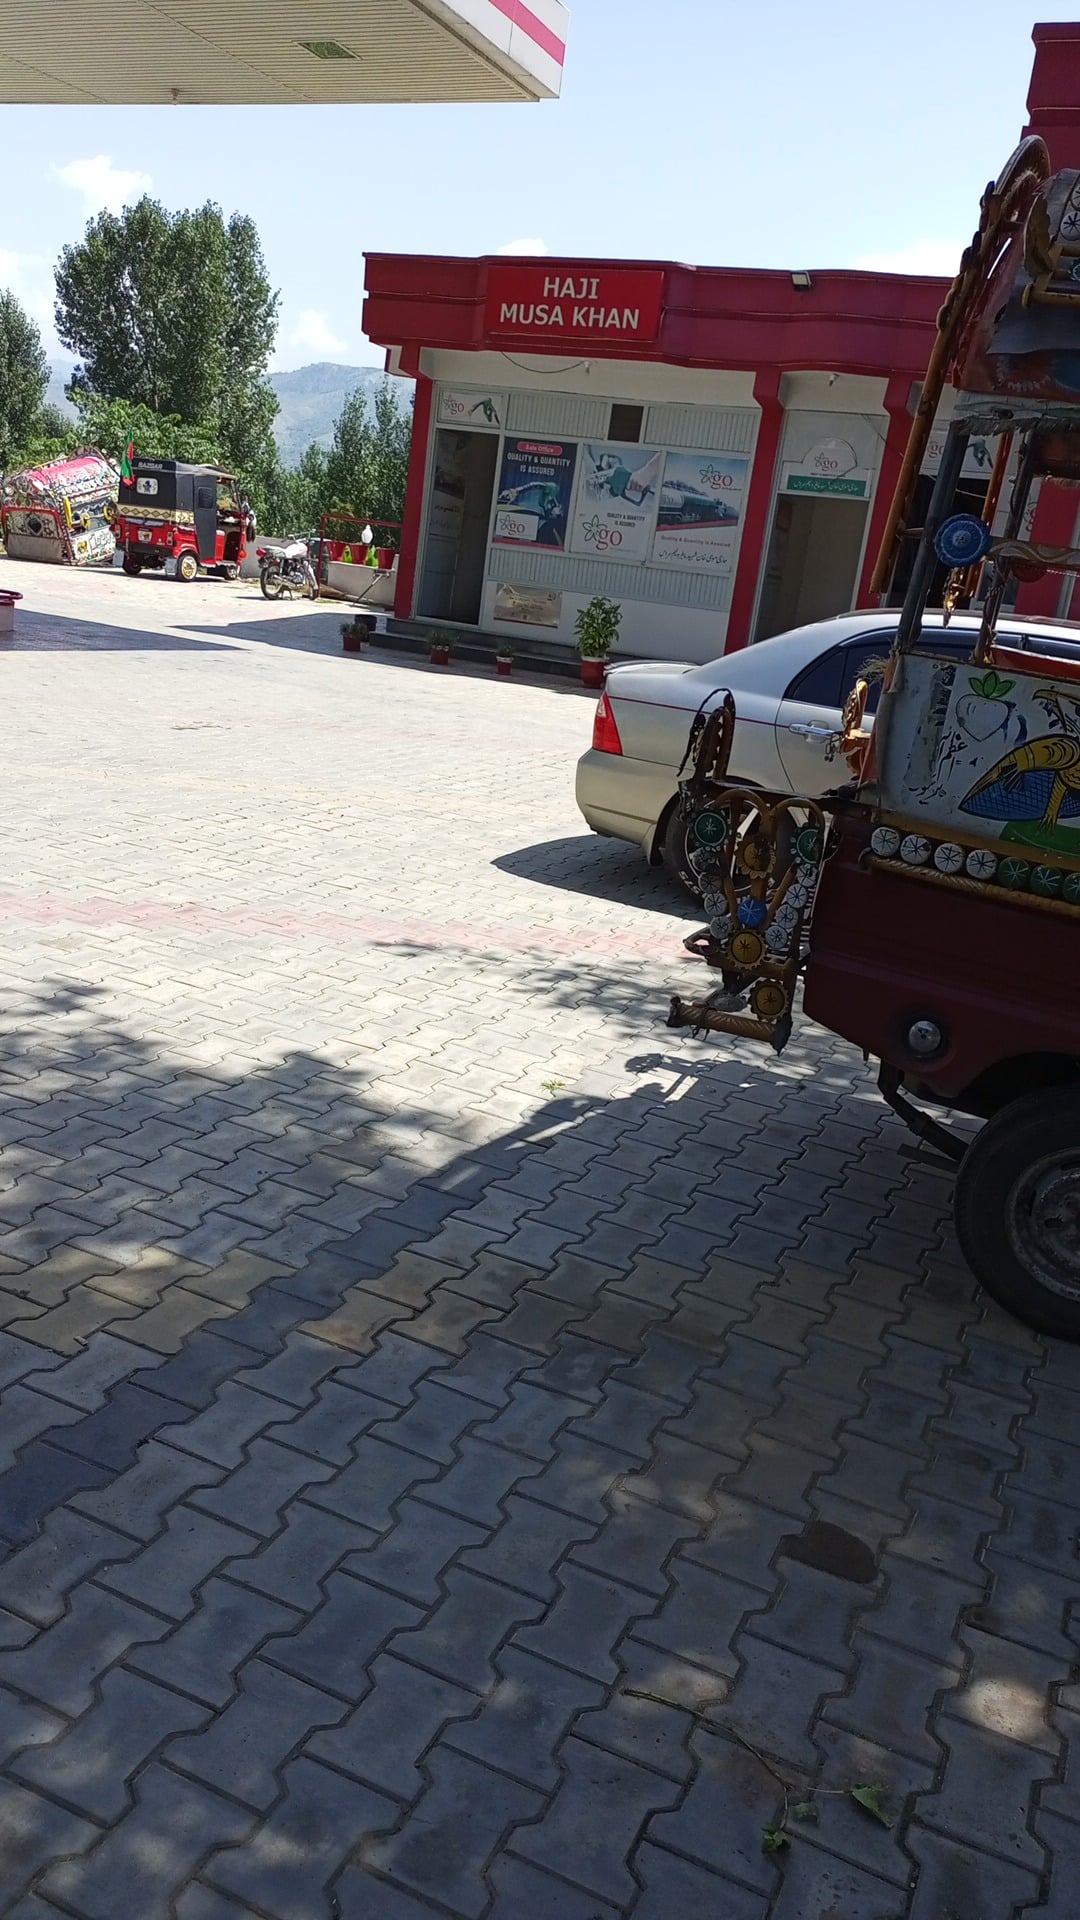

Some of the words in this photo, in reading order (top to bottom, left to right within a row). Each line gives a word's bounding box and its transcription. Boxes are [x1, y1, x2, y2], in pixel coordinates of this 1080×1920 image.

[543, 276, 600, 300] HAJI
[499, 303, 564, 326] MUSA
[572, 306, 640, 330] KHAN
[450, 402, 465, 415] go
[507, 452, 532, 463] QUALITY
[540, 457, 571, 467] QUANTITY
[821, 459, 838, 472] go
[520, 464, 527, 472] IS
[528, 465, 555, 476] ASSURED
[710, 473, 733, 490] go
[507, 522, 525, 536] go
[595, 528, 623, 551] go
